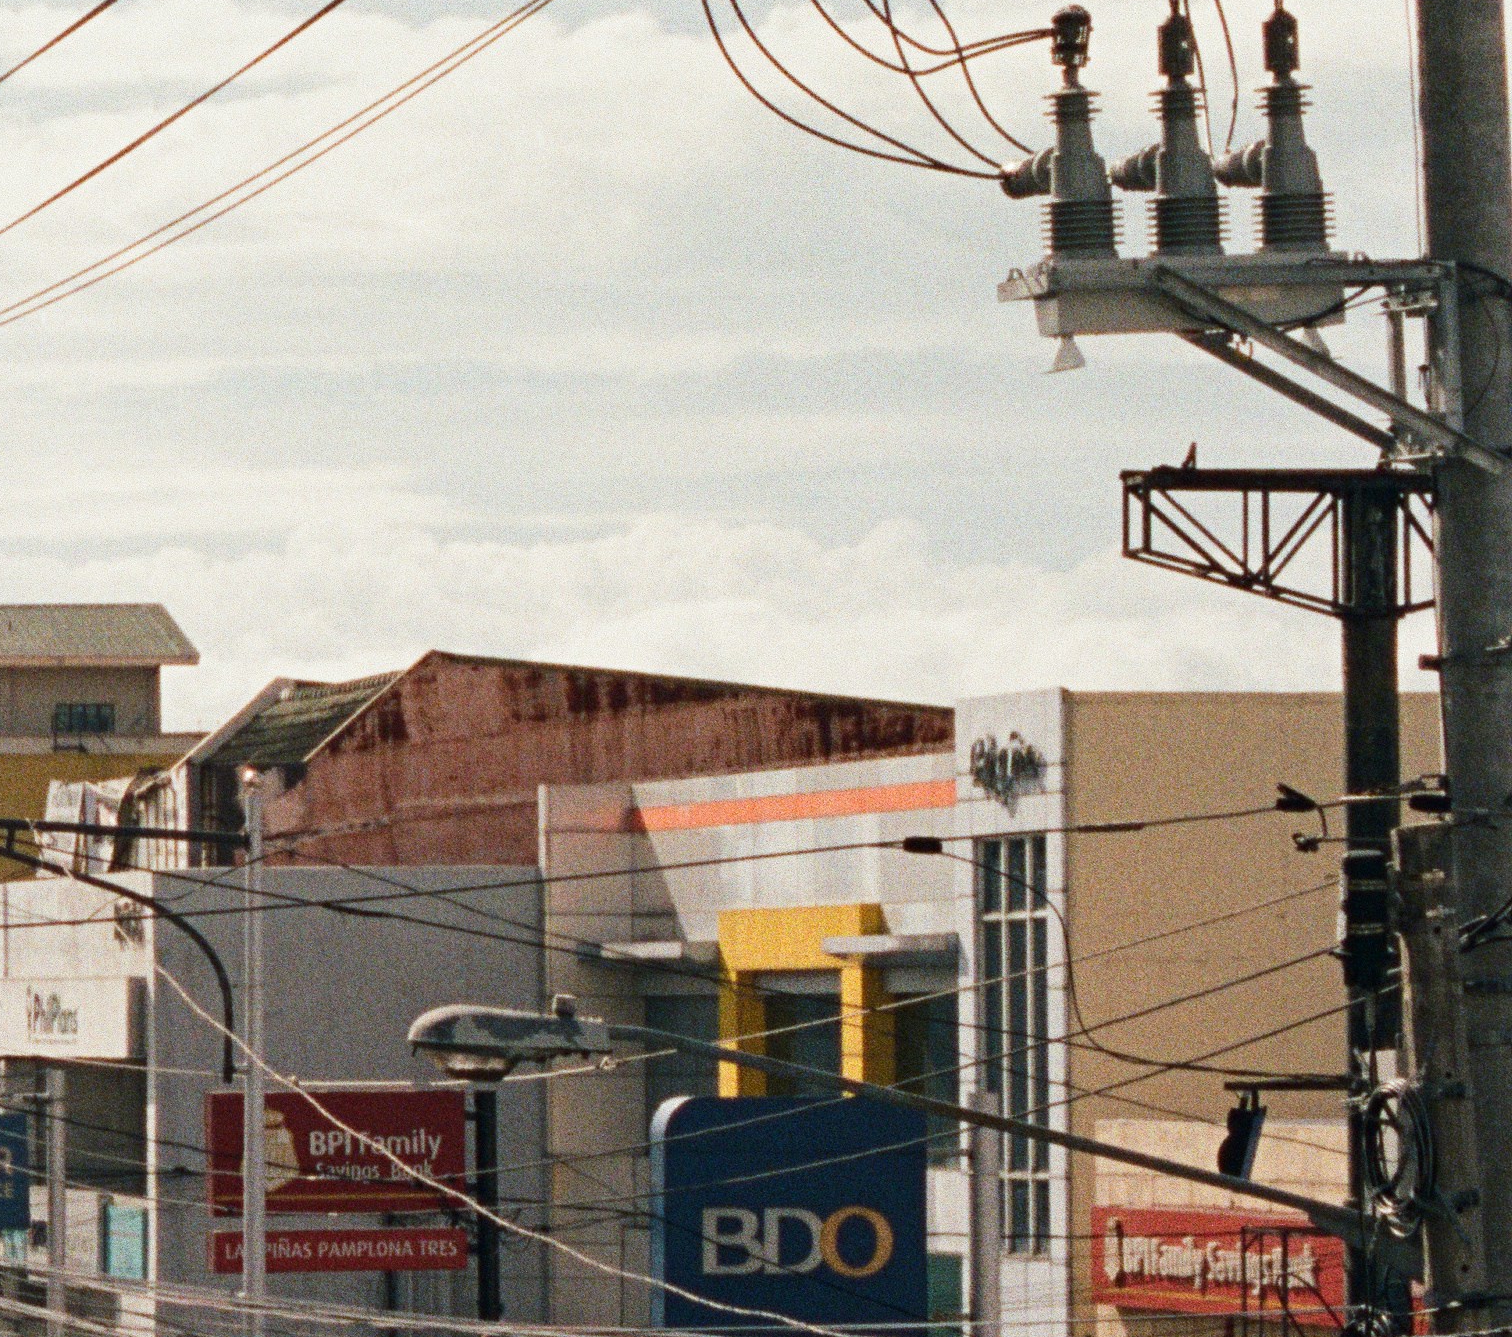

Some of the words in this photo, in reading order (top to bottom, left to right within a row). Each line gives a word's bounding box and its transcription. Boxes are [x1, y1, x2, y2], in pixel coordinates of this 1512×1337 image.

[309, 1129, 352, 1156] BPI
[357, 1127, 442, 1160] Family
[225, 1242, 246, 1260] LA
[318, 1239, 413, 1258] PAMPLONA
[419, 1238, 458, 1257] TRES
[702, 1205, 894, 1279] BDO
